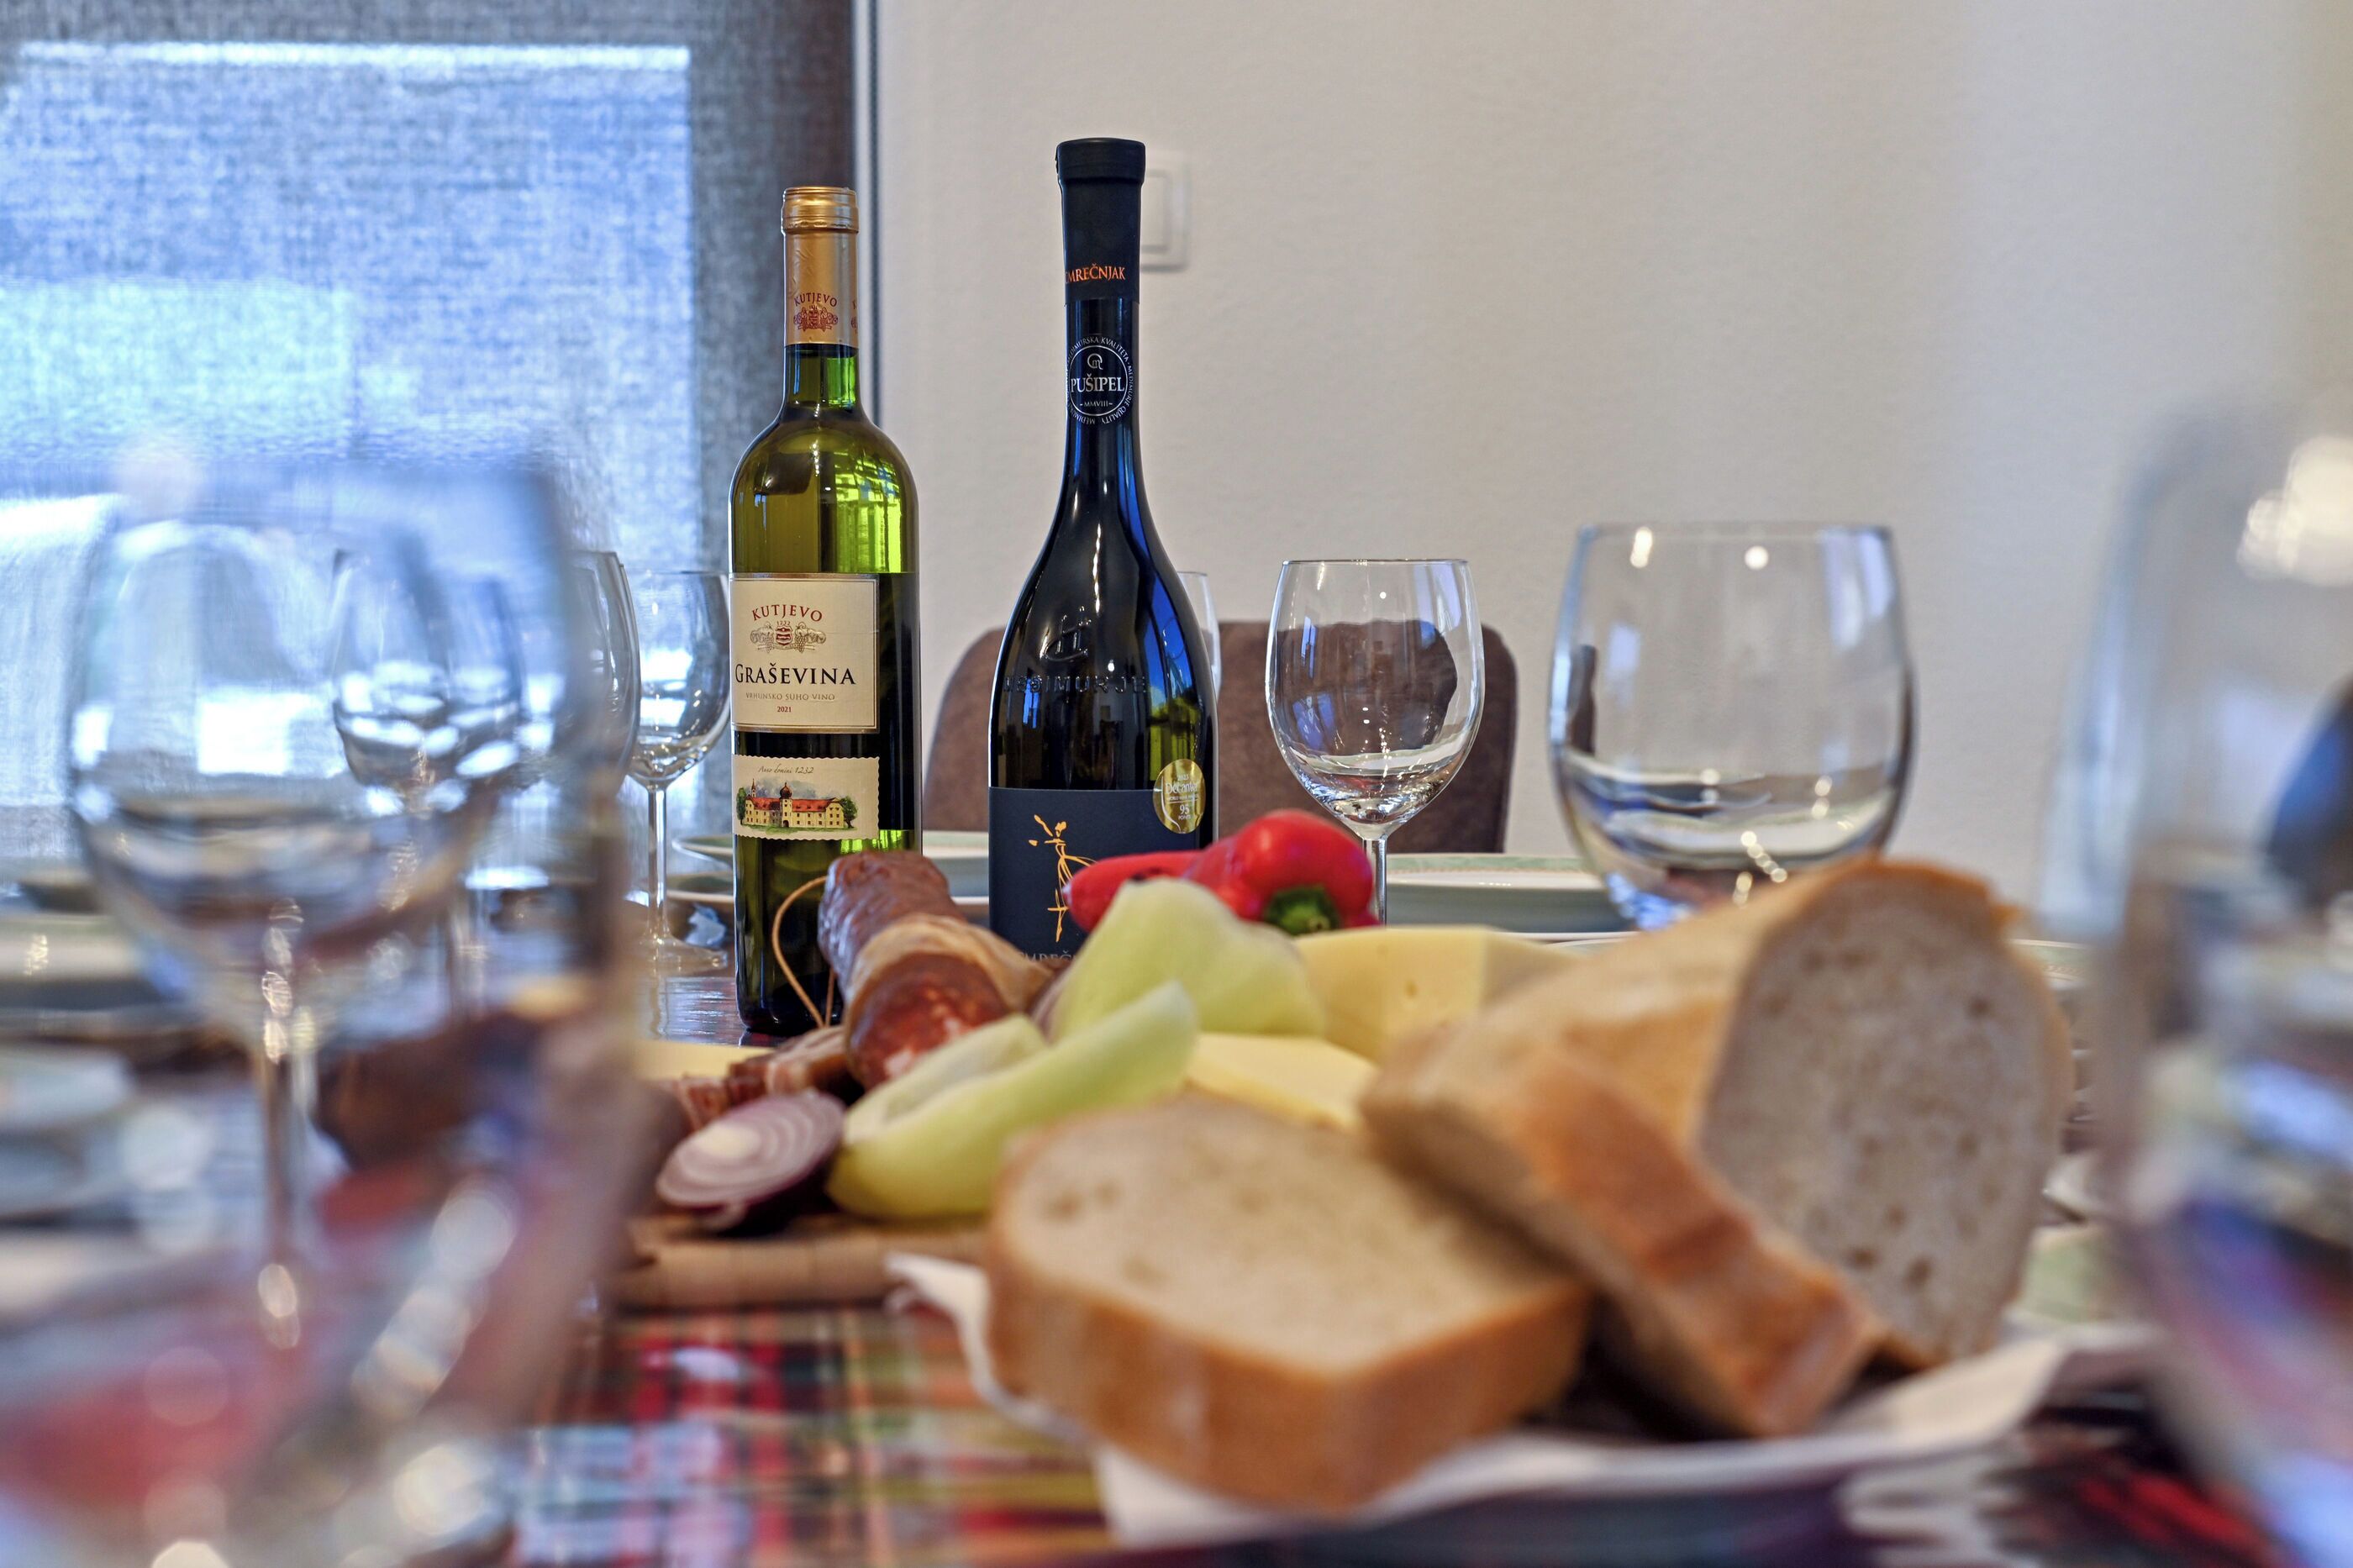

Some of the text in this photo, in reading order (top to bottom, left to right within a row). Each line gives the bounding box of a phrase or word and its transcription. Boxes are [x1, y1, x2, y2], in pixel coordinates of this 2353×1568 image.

[794, 292, 837, 307] KUTJEVO
[1101, 337, 1129, 361] KVALITETA
[1070, 373, 1125, 392] PUŠIPEL
[1102, 405, 1127, 424] QUALITY
[752, 604, 823, 622] KUTJEVO
[795, 766, 814, 775] 1232
[1179, 804, 1190, 815] 95
